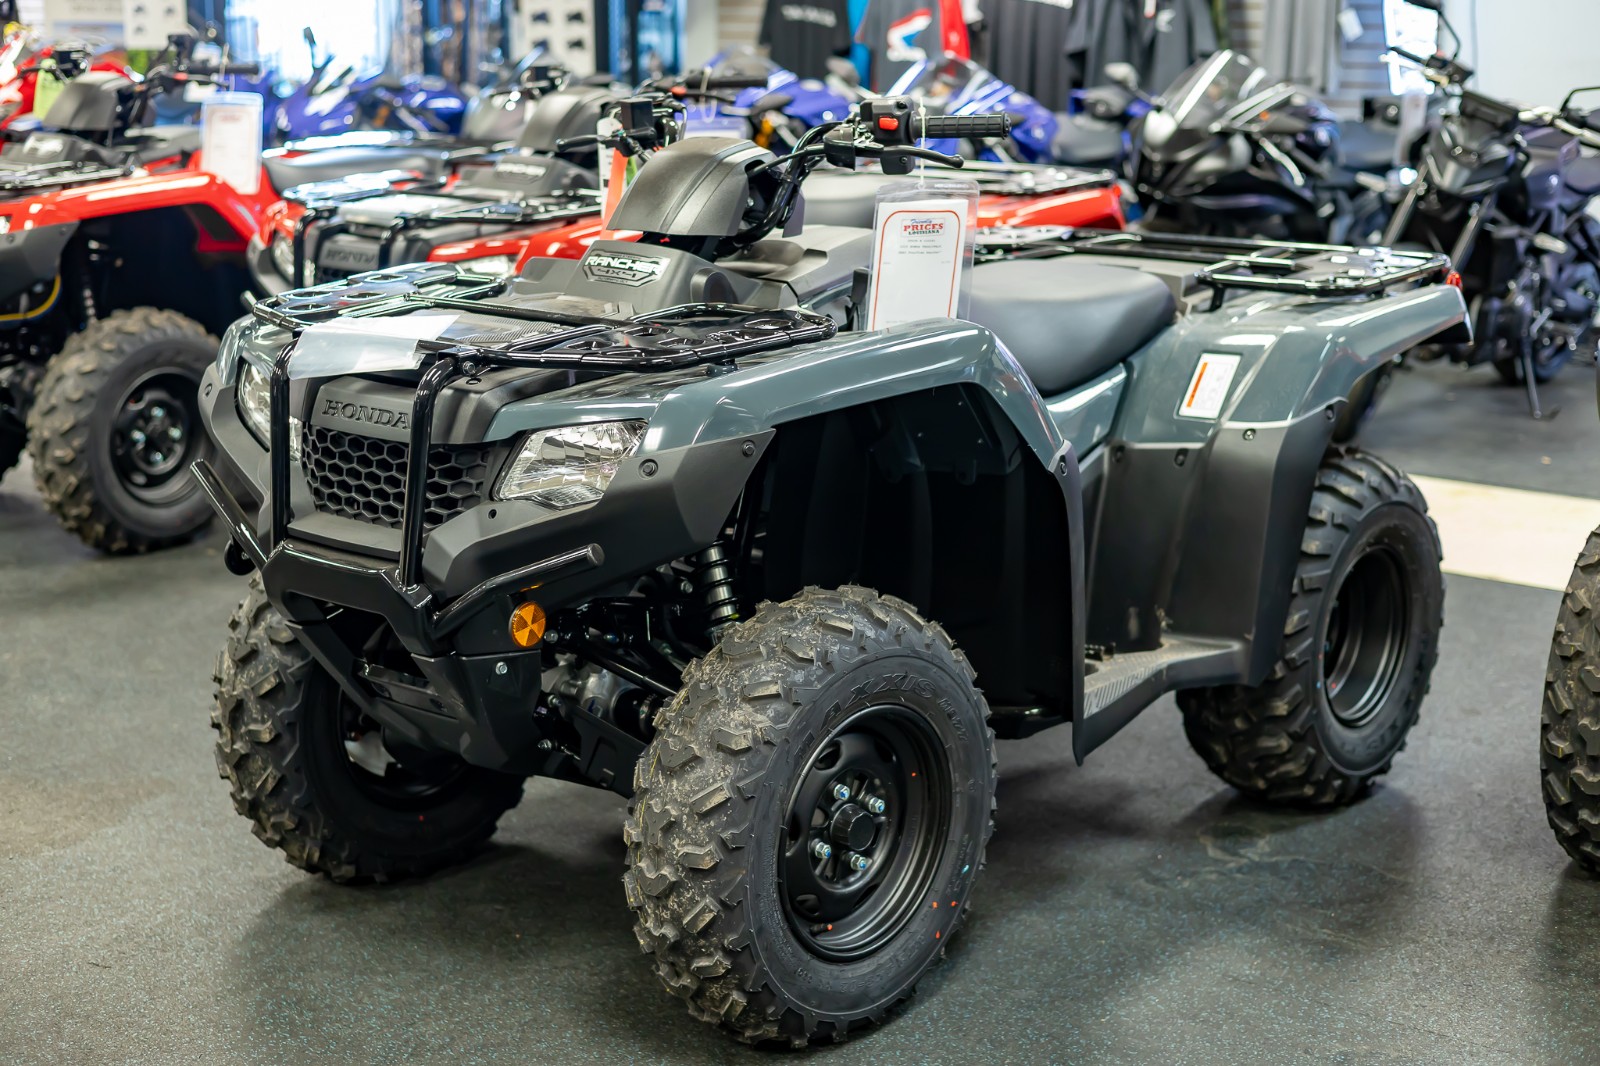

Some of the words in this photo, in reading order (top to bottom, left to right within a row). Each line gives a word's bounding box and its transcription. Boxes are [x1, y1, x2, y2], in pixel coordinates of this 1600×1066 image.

[903, 223, 944, 232] PRICES
[585, 256, 664, 276] RANCHER
[322, 399, 411, 430] HONDA
